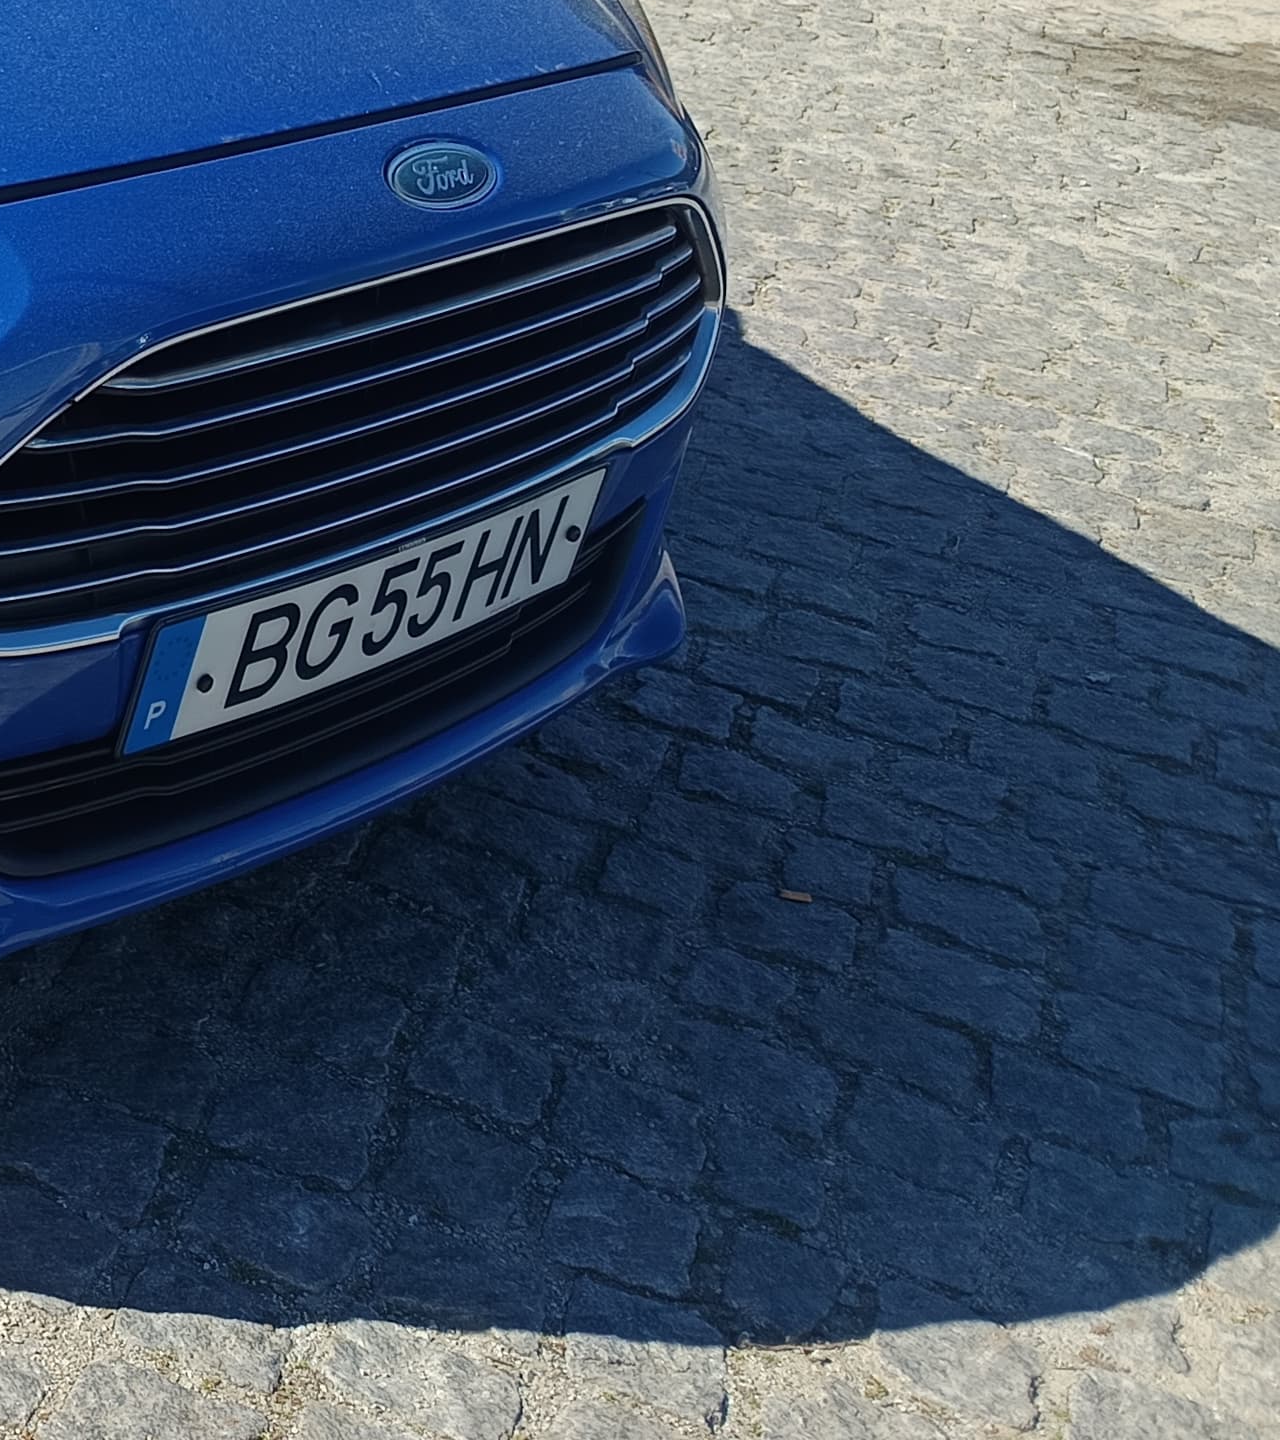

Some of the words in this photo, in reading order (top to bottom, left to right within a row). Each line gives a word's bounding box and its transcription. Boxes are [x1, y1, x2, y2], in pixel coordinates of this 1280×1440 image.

[411, 155, 474, 196] Ford
[223, 494, 571, 710] BG55HN
[143, 699, 167, 731] P
